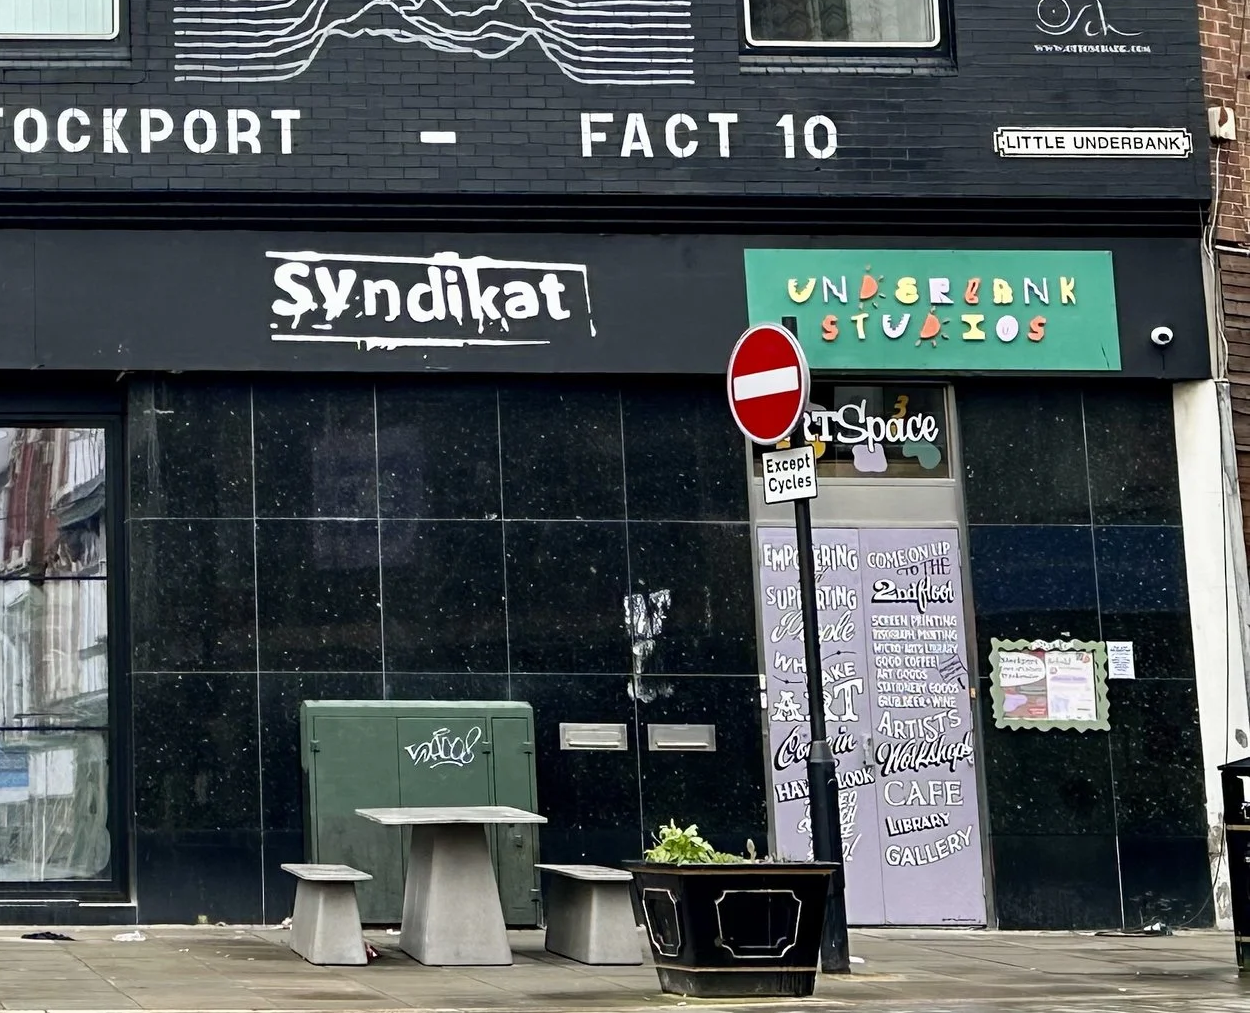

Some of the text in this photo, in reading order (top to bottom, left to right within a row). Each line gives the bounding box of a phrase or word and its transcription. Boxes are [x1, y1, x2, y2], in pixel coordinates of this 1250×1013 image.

[580, 112, 738, 158] FACT
[775, 114, 837, 159] 10
[1006, 136, 1180, 150] LITTLE UNDERBANK
[271, 261, 571, 329] Syndikat
[787, 273, 1077, 307] UNDERBANK
[821, 311, 1048, 343] STUDIOS
[766, 453, 811, 473] Except
[769, 474, 812, 494] Cycles
[867, 541, 950, 568] COME ON UP
[896, 557, 951, 576] TO THE
[871, 579, 917, 603] 2nd
[871, 615, 957, 627] SCREEN PRINTING
[875, 656, 902, 668] GOOD
[877, 709, 962, 742] ARTISTS
[884, 780, 964, 806] CAFE
[886, 812, 950, 836] LIBRARY
[885, 826, 973, 867] GALLERY
